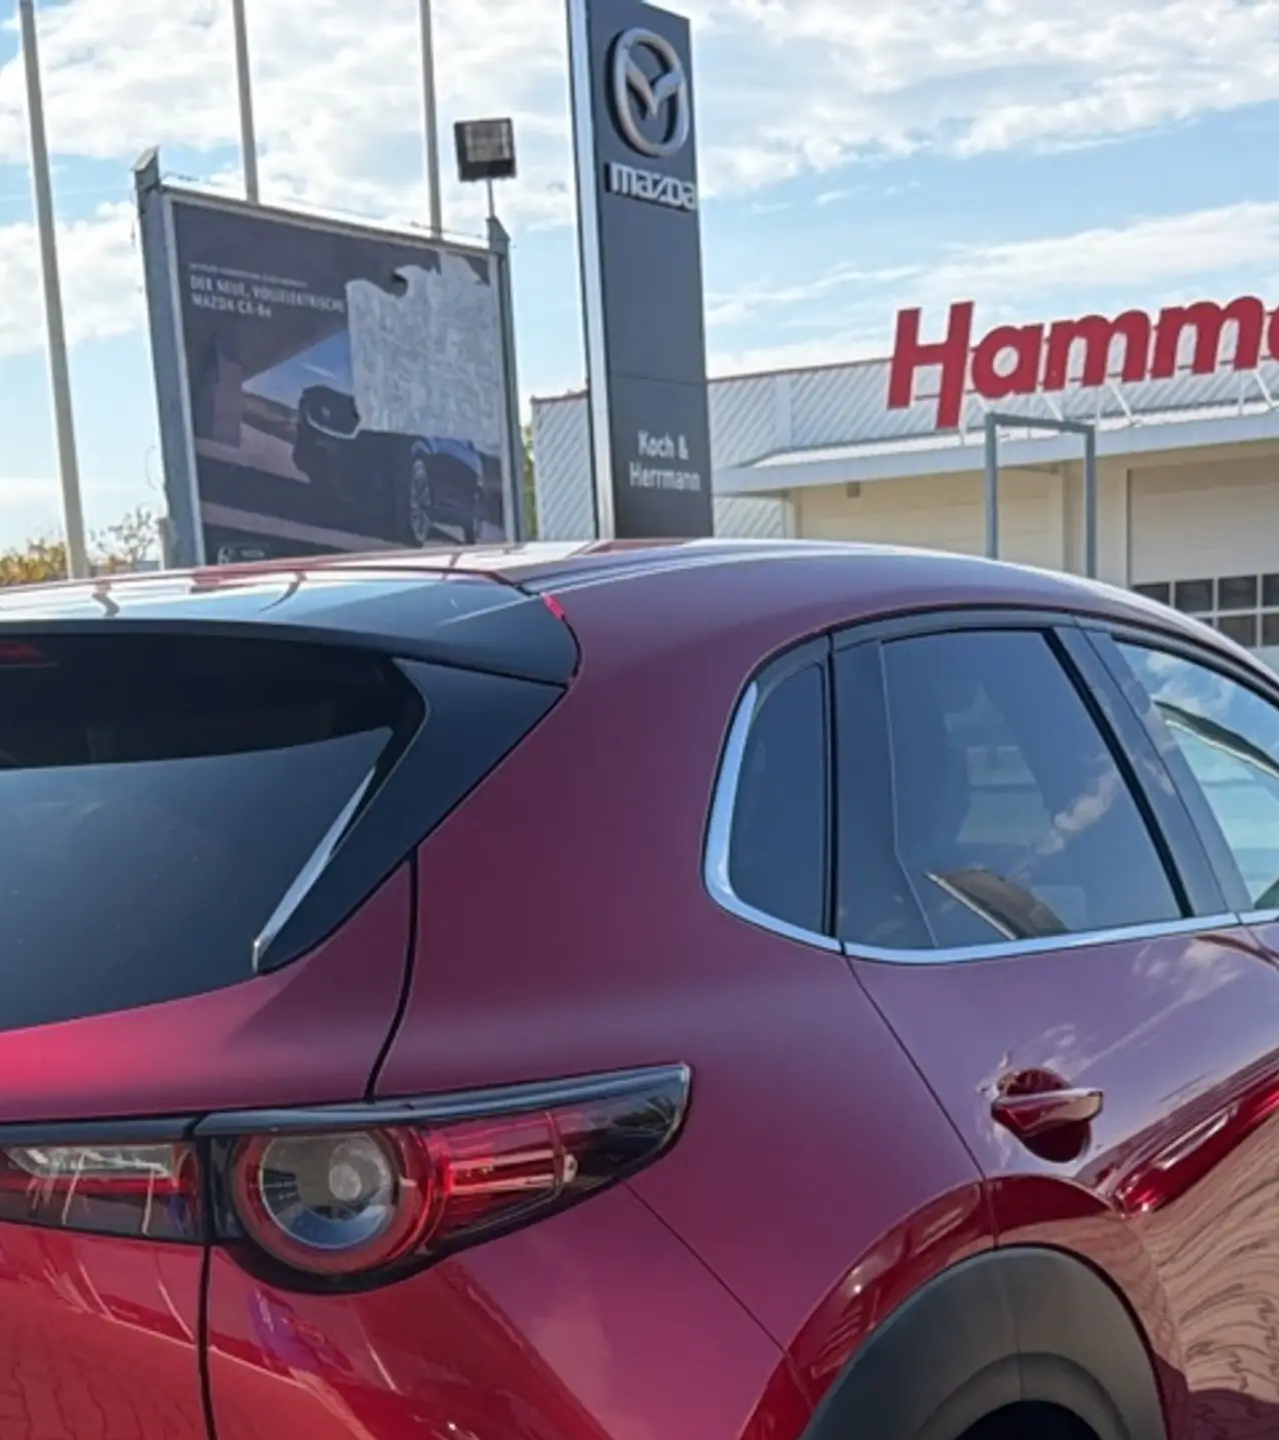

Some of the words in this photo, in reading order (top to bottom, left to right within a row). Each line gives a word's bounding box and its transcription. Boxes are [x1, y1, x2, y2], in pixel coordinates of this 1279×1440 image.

[610, 161, 696, 210] mazda
[637, 430, 675, 458] Koch
[629, 461, 701, 491] Herrmann
